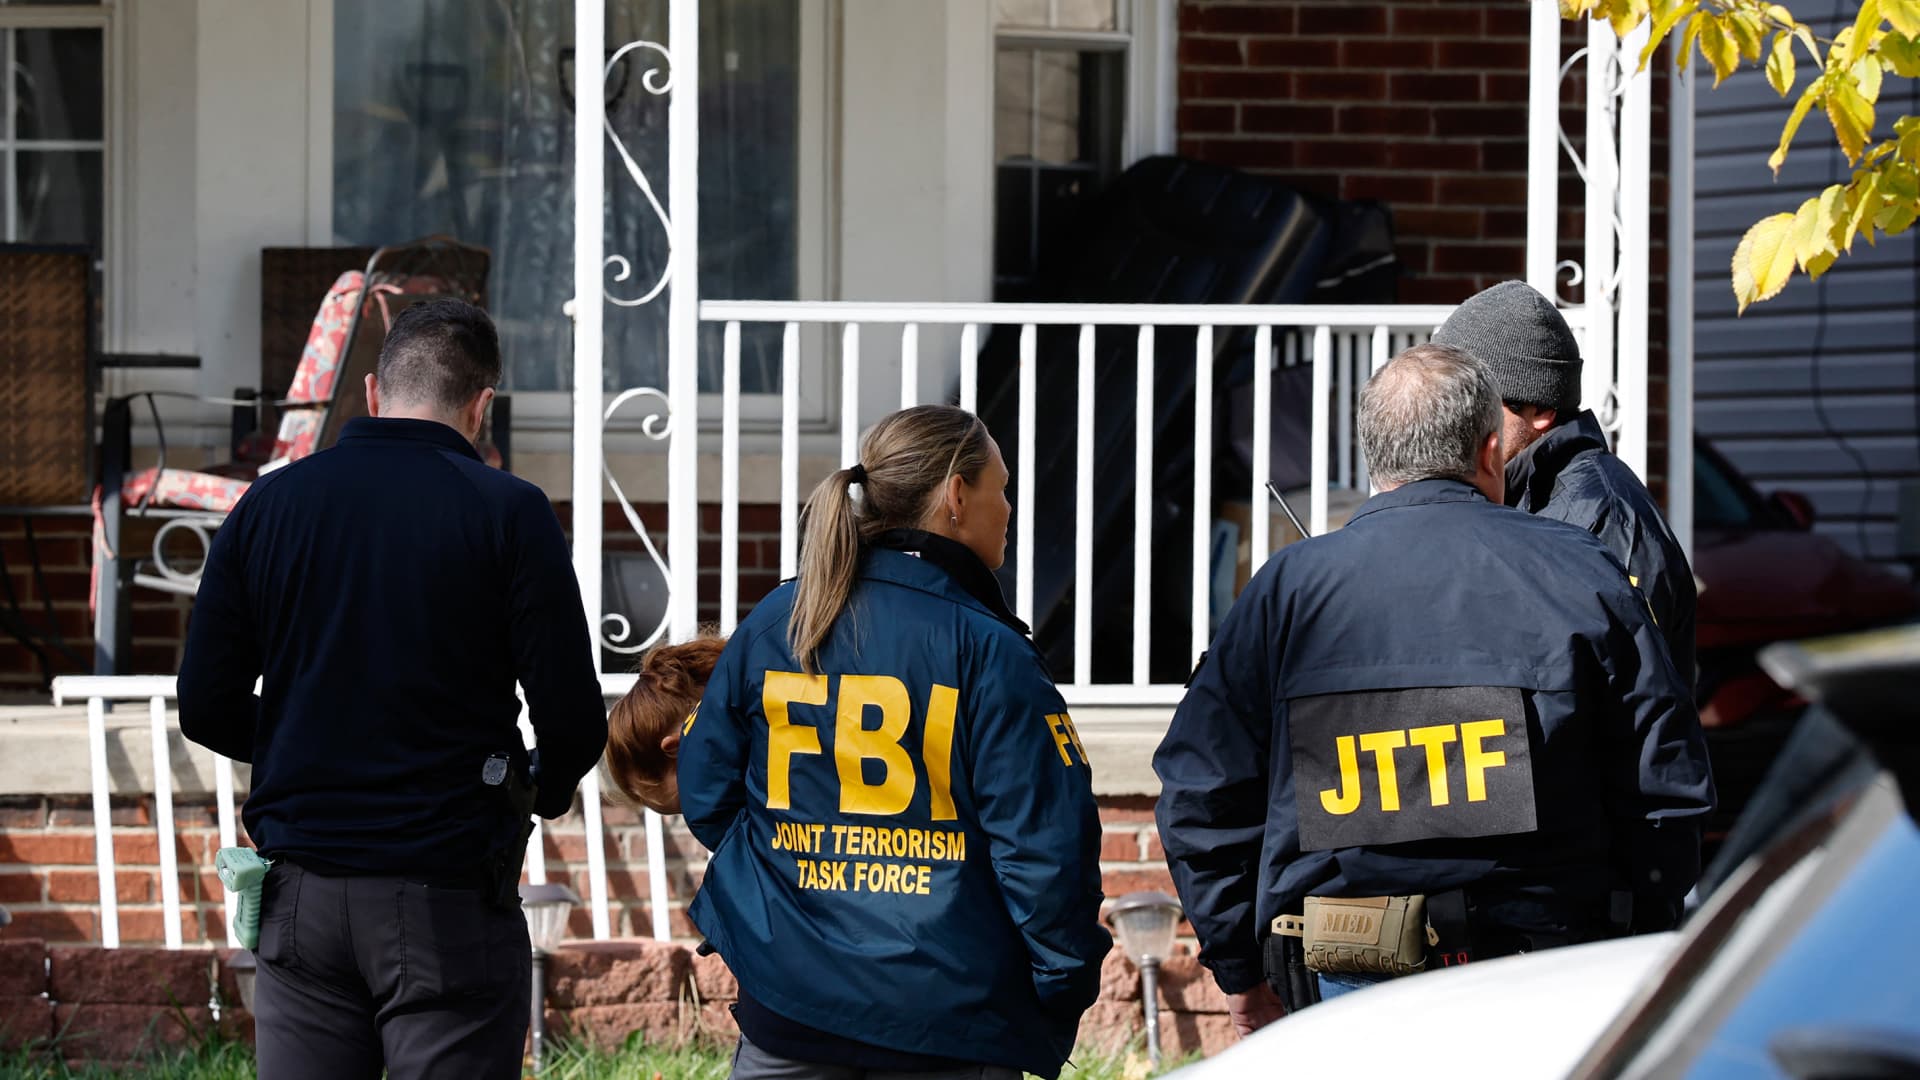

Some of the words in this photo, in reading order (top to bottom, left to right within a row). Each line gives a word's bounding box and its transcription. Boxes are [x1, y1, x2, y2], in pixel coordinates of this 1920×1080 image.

[762, 670, 960, 821] FBI
[1319, 718, 1506, 816] JTTF
[771, 822, 826, 854] JOINT
[831, 825, 966, 861] TERRORISM
[797, 859, 848, 891] TASK
[853, 862, 932, 895] FORCE
[1323, 911, 1374, 934] MED
